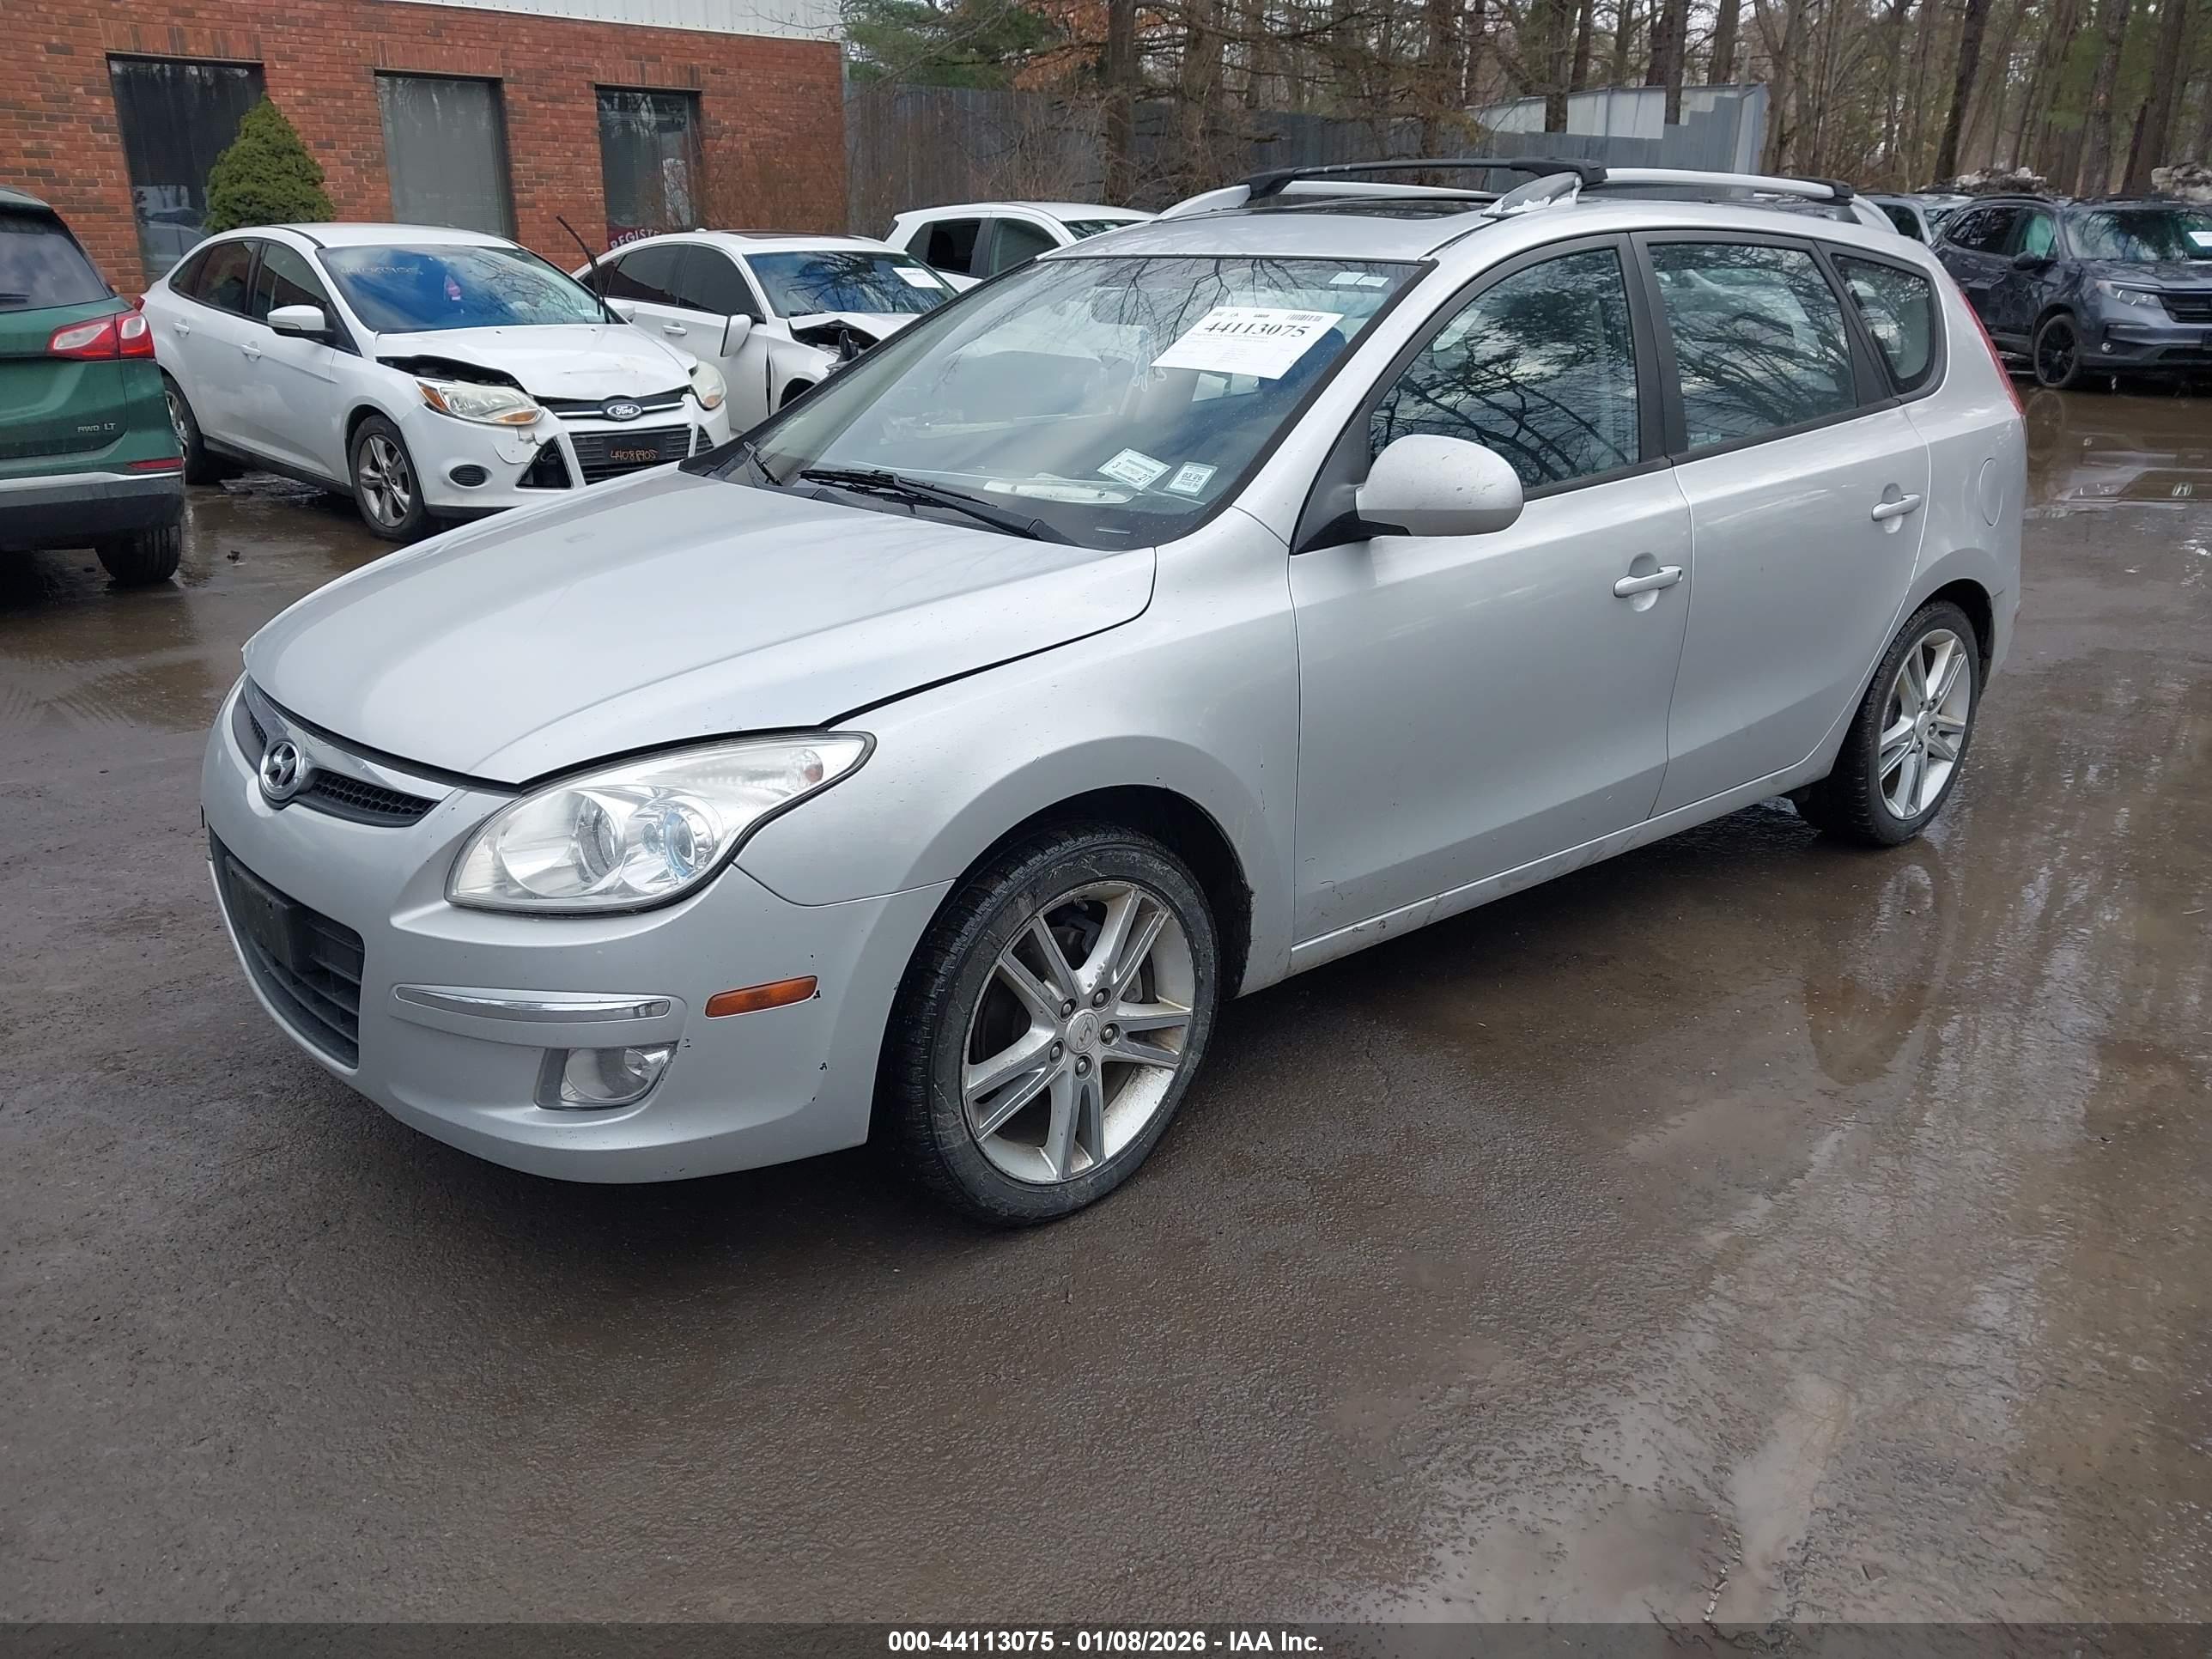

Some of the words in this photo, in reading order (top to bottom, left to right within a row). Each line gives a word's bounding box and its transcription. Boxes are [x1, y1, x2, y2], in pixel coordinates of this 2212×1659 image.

[611, 228, 663, 249] REGIST
[1204, 322, 1311, 337] 44113075
[615, 404, 635, 415] Ford
